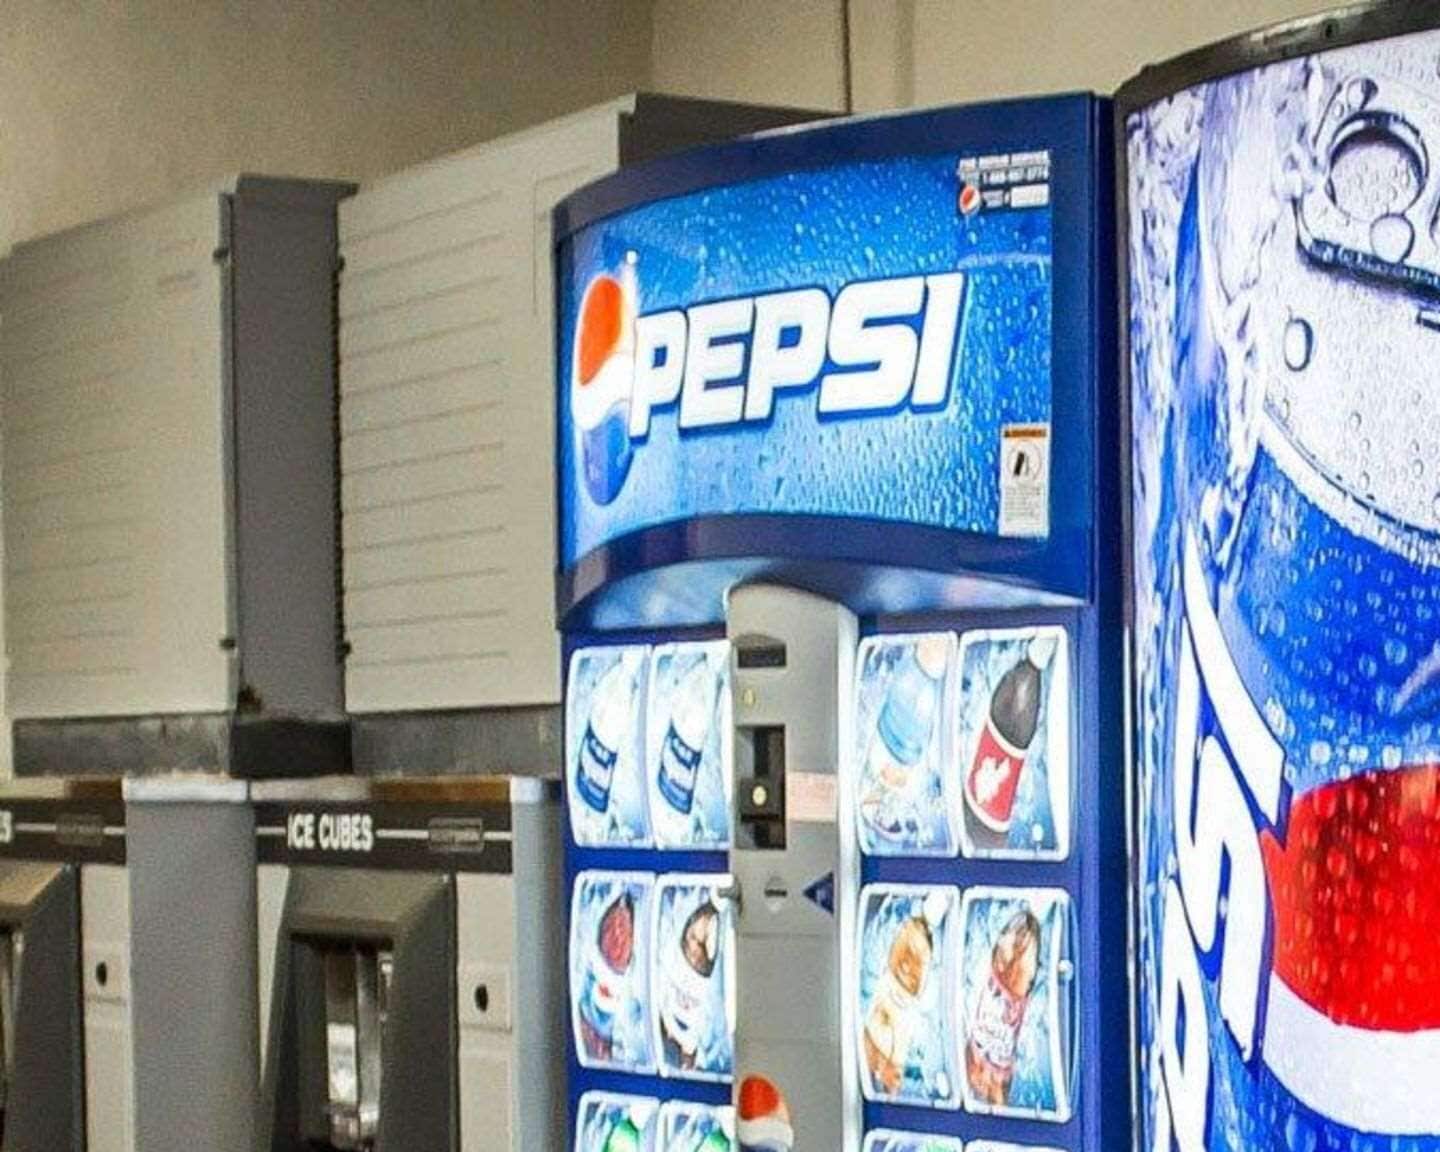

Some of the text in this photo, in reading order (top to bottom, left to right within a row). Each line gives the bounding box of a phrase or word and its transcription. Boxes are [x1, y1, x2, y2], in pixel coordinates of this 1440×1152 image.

[628, 272, 966, 438] PEPSI
[287, 813, 374, 851] ICE CUBES
